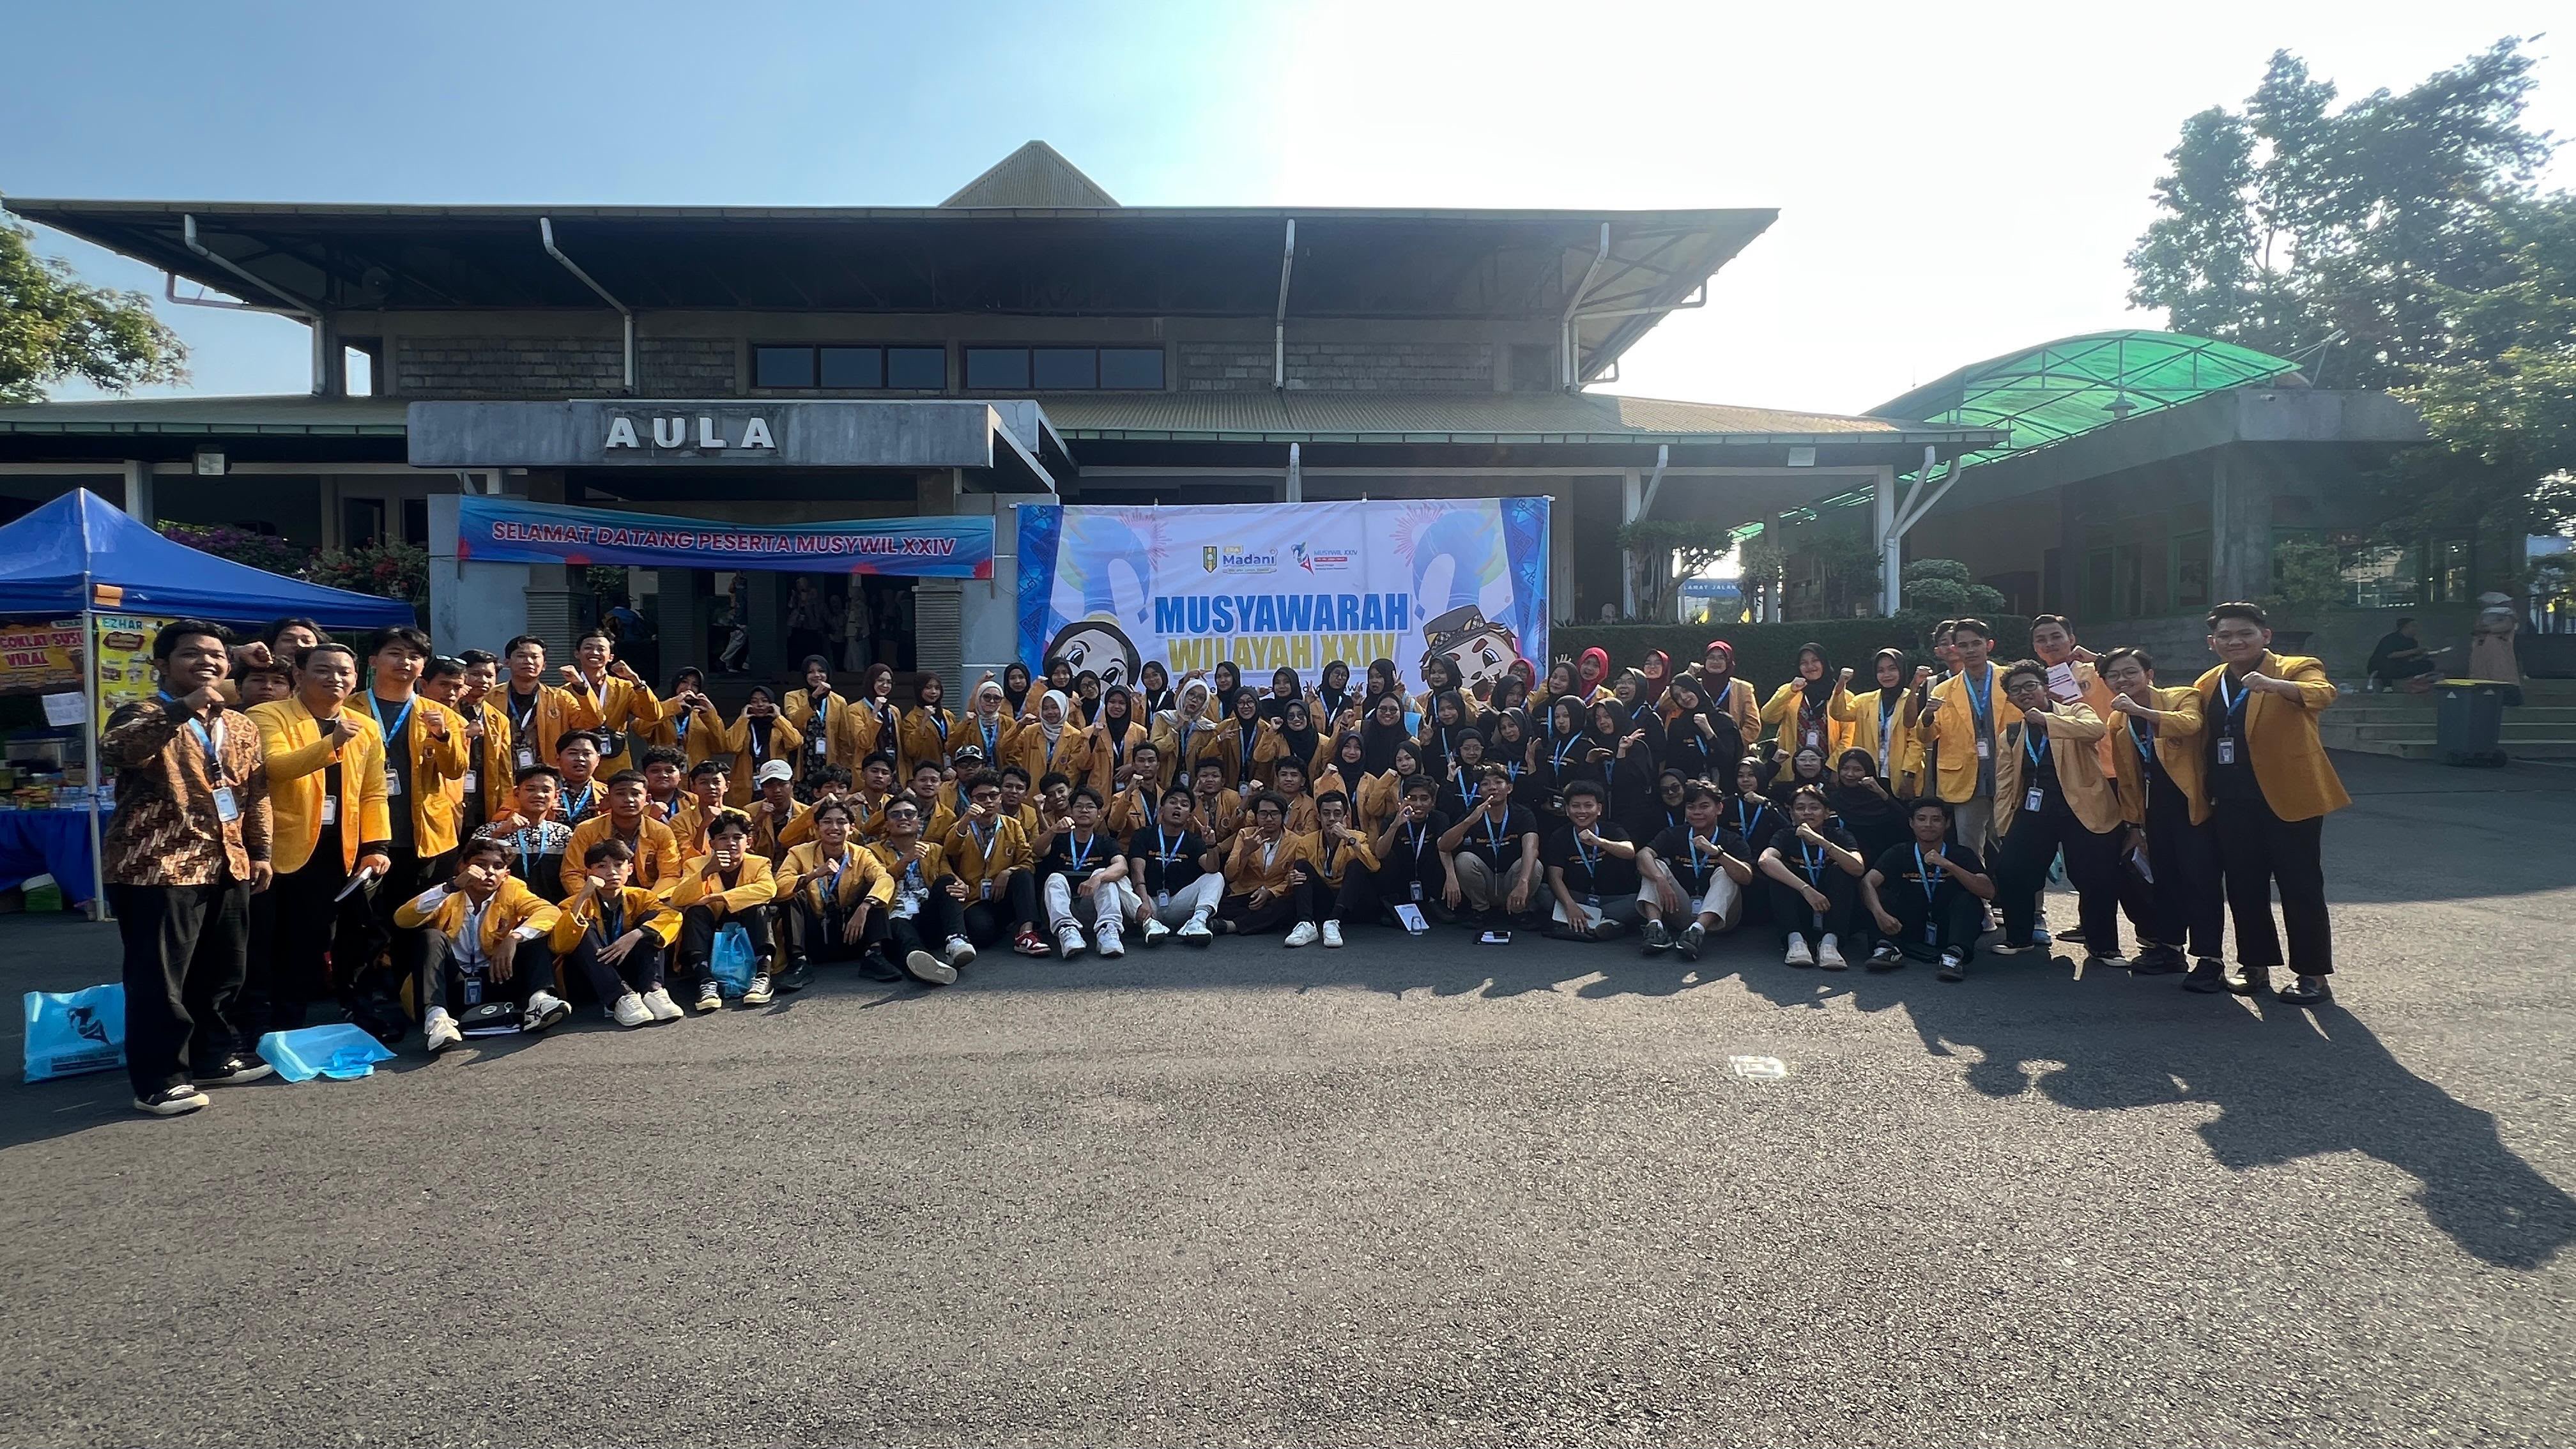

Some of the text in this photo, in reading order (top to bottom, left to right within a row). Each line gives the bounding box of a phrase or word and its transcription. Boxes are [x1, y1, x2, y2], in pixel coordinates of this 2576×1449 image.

[606, 417, 776, 448] AULA
[493, 521, 956, 556] SELAMAT DATANG PESERTA MUSYWIL XXIV
[1223, 549, 1275, 565] Madani
[102, 618, 143, 630] EZHAR
[1155, 593, 1407, 633] MUSYAWARAH
[1319, 633, 1395, 668] XXIV
